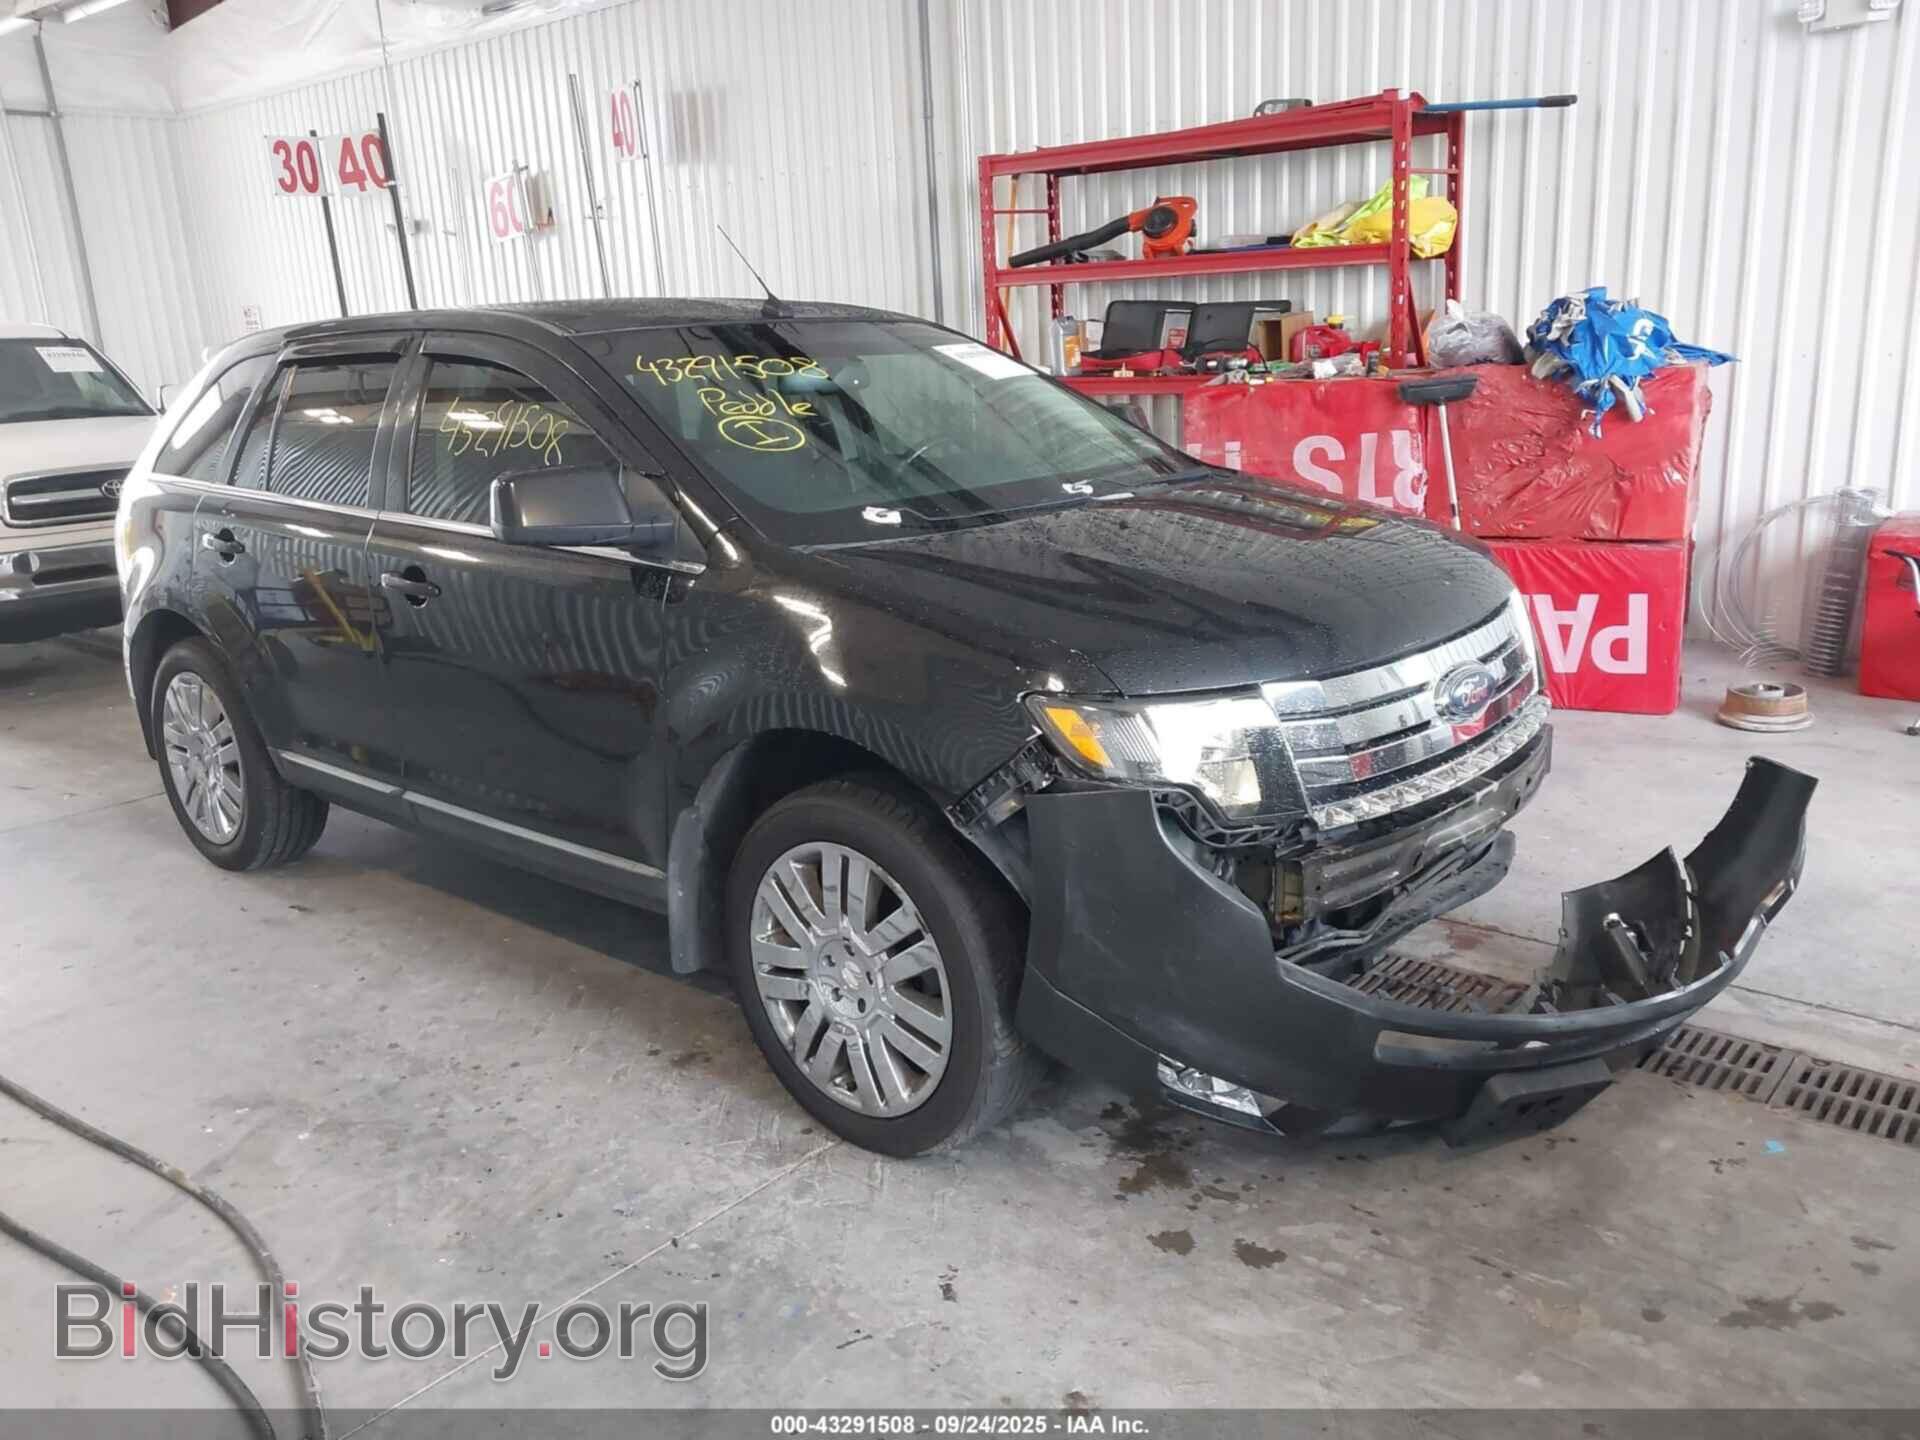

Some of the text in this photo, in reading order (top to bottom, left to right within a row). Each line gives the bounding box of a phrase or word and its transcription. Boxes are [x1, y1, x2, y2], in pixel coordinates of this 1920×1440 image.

[610, 90, 635, 158] 40
[272, 140, 319, 193] 30
[338, 133, 389, 192] 40
[636, 355, 829, 386] 43291508
[697, 387, 817, 417] Peddle
[1523, 593, 1648, 674] PA
[1453, 676, 1489, 708] Ford
